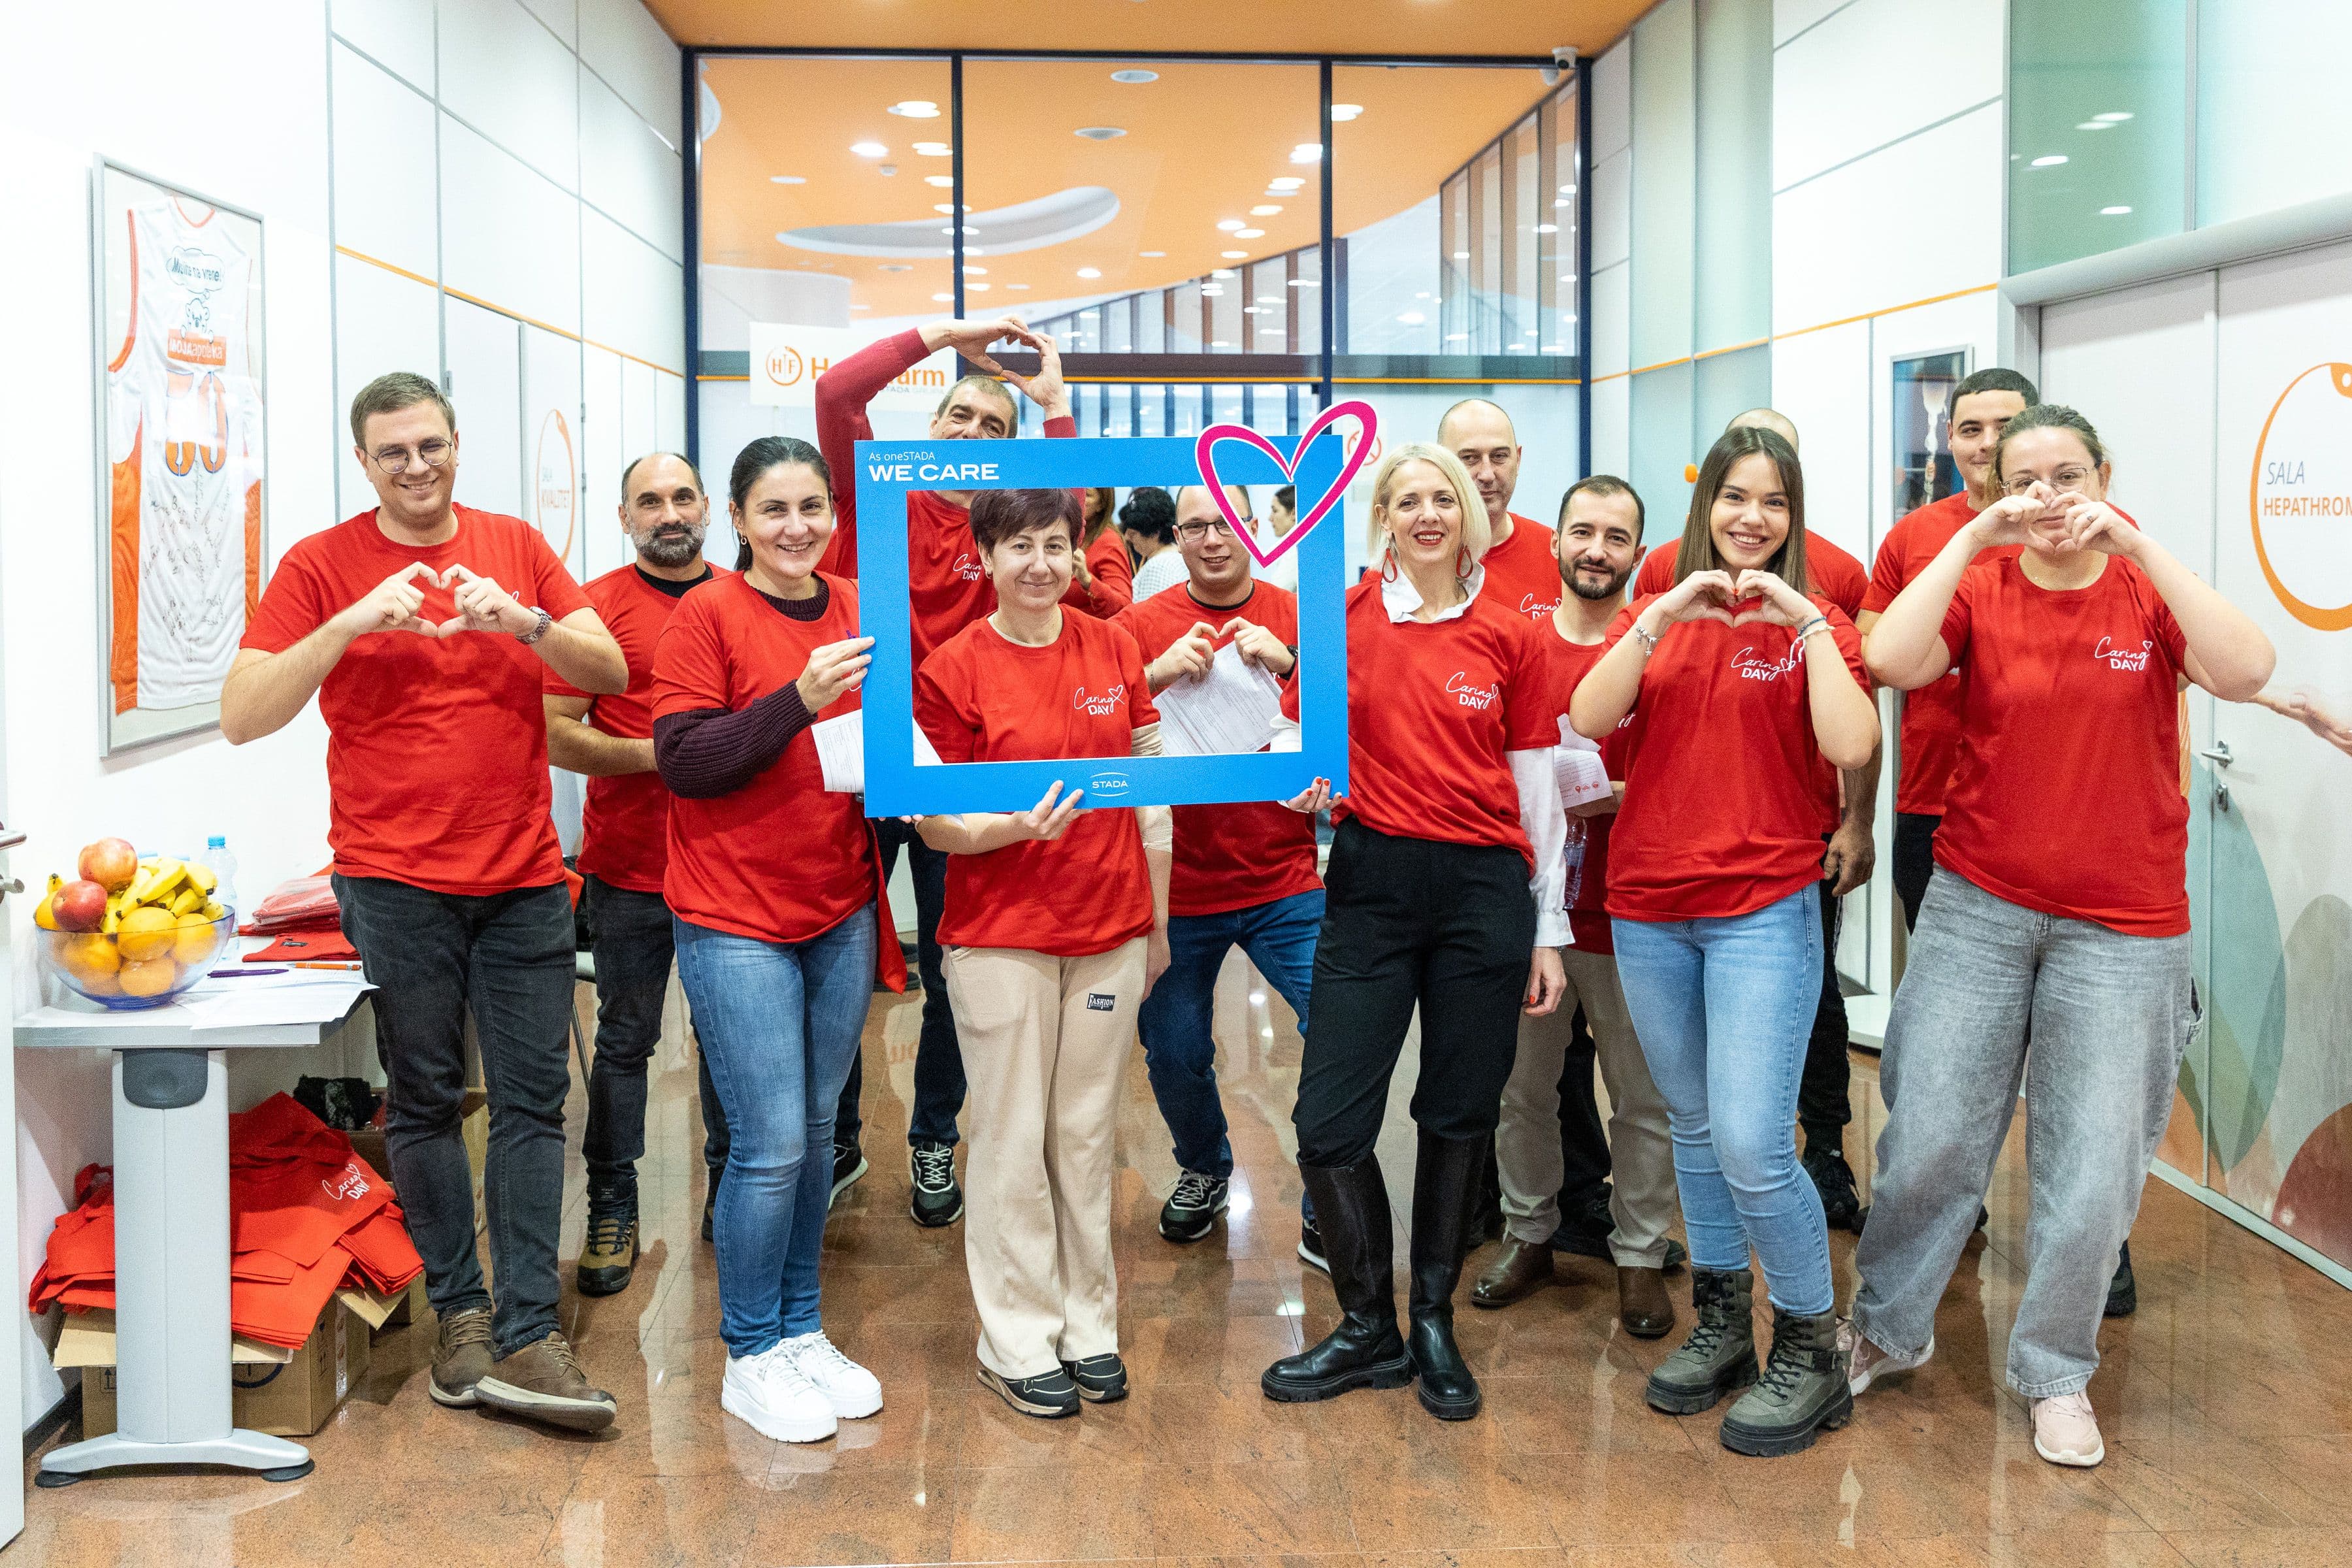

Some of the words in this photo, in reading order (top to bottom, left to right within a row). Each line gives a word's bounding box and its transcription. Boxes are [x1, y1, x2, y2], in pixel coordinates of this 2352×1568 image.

[868, 451, 881, 461] As
[884, 451, 936, 461] oneSTADA
[868, 465, 914, 482] WE
[919, 463, 1000, 482] CARE
[2266, 461, 2306, 485] SALA
[953, 553, 983, 572] Carin
[962, 570, 980, 581] DAY
[2094, 636, 2149, 671] Caring
[1730, 647, 1781, 681] Caring
[2110, 658, 2138, 672] DAY
[1741, 667, 1771, 681] DAY
[1445, 671, 1493, 710] Caring
[1073, 687, 1115, 713] Caring
[1458, 693, 1485, 710] DAY
[1087, 704, 1110, 715] DAY
[1092, 780, 1129, 789] STADA
[321, 1173, 370, 1200] Caring
[346, 1183, 370, 1200] DAY
